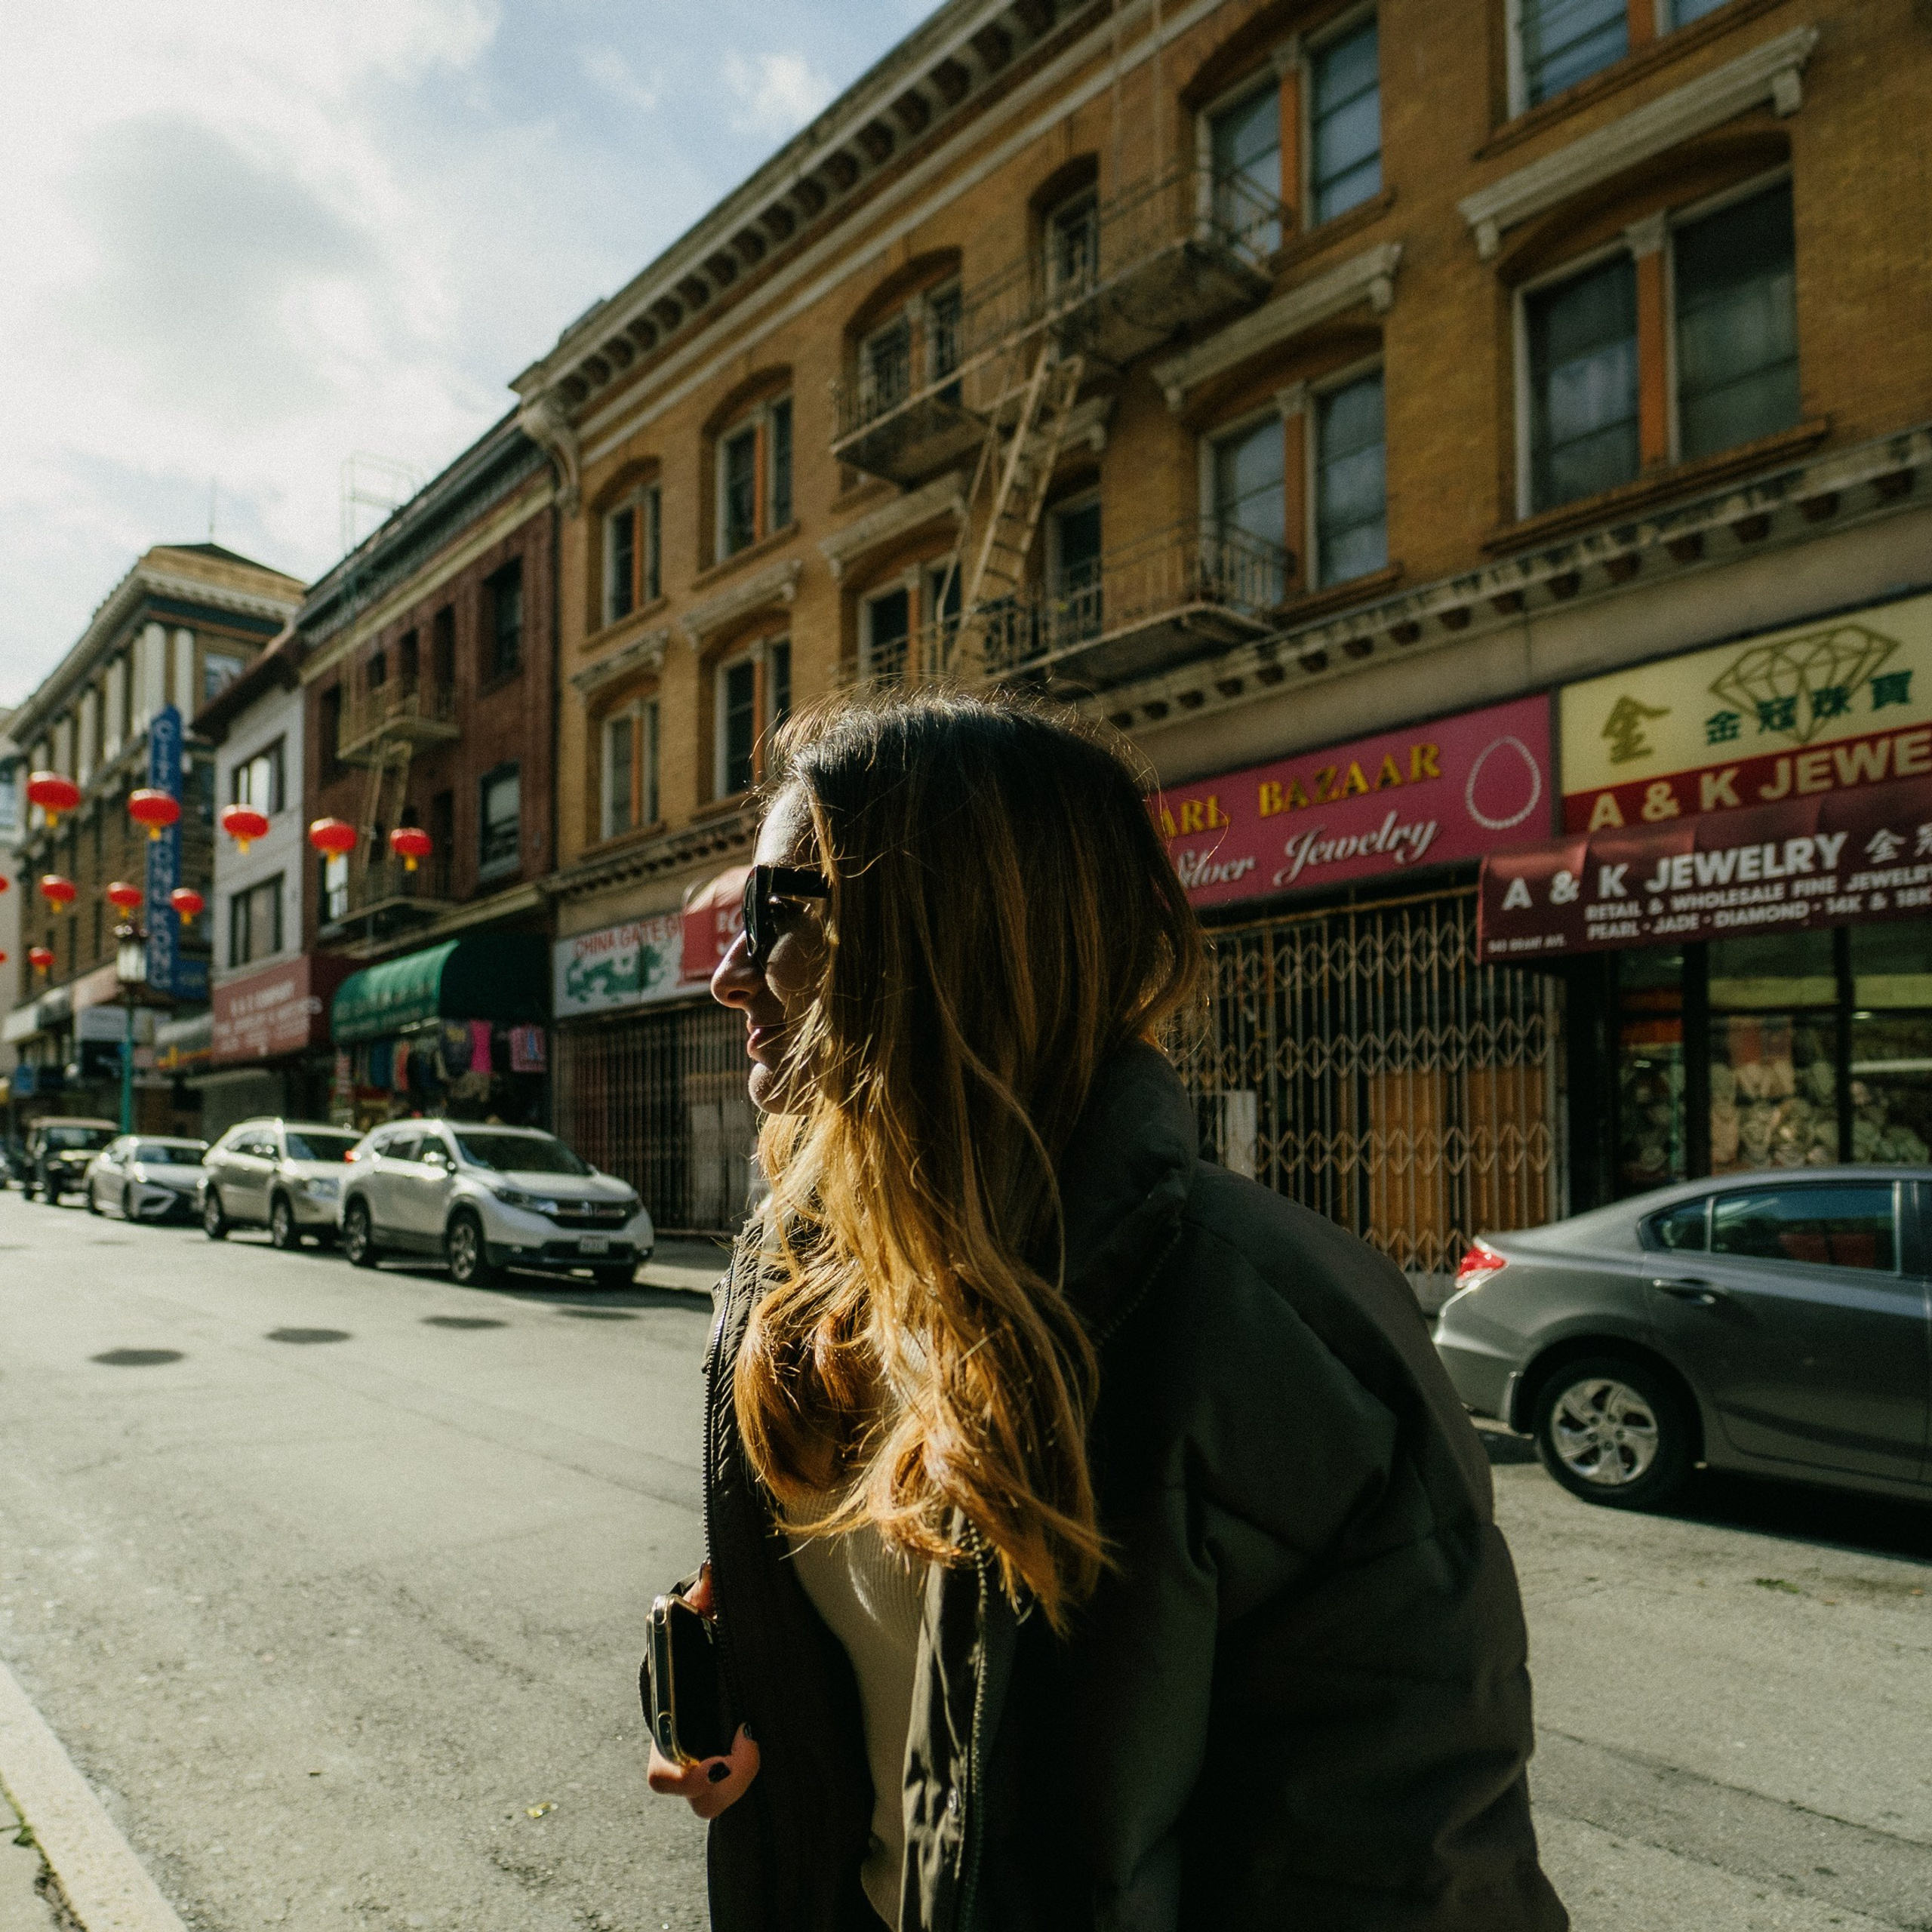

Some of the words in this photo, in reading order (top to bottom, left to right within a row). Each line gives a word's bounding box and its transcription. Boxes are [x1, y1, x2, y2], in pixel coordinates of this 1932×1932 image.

[1258, 743, 1442, 819] BAZAAR
[1588, 792, 1625, 832] A
[1641, 781, 1680, 822] &
[1700, 768, 1742, 812] K
[1758, 729, 1932, 800] JEWE
[1272, 810, 1442, 888] Jewelry
[1502, 877, 1533, 911] A
[1549, 870, 1580, 905] &
[1598, 863, 1629, 899] K
[1644, 832, 1849, 894] JEWELRY
[1586, 900, 1641, 921] RETAIL
[1647, 897, 1664, 915] &
[1669, 882, 1786, 912] WHOLESALE
[1791, 875, 1838, 897] FINE
[1587, 920, 1640, 940] PEARL
[1653, 912, 1700, 934] JADE
[1712, 901, 1810, 928] DIAMOND
[149, 908, 173, 987] KONG
[574, 931, 615, 958] CHINA
[620, 918, 662, 948] GATE
